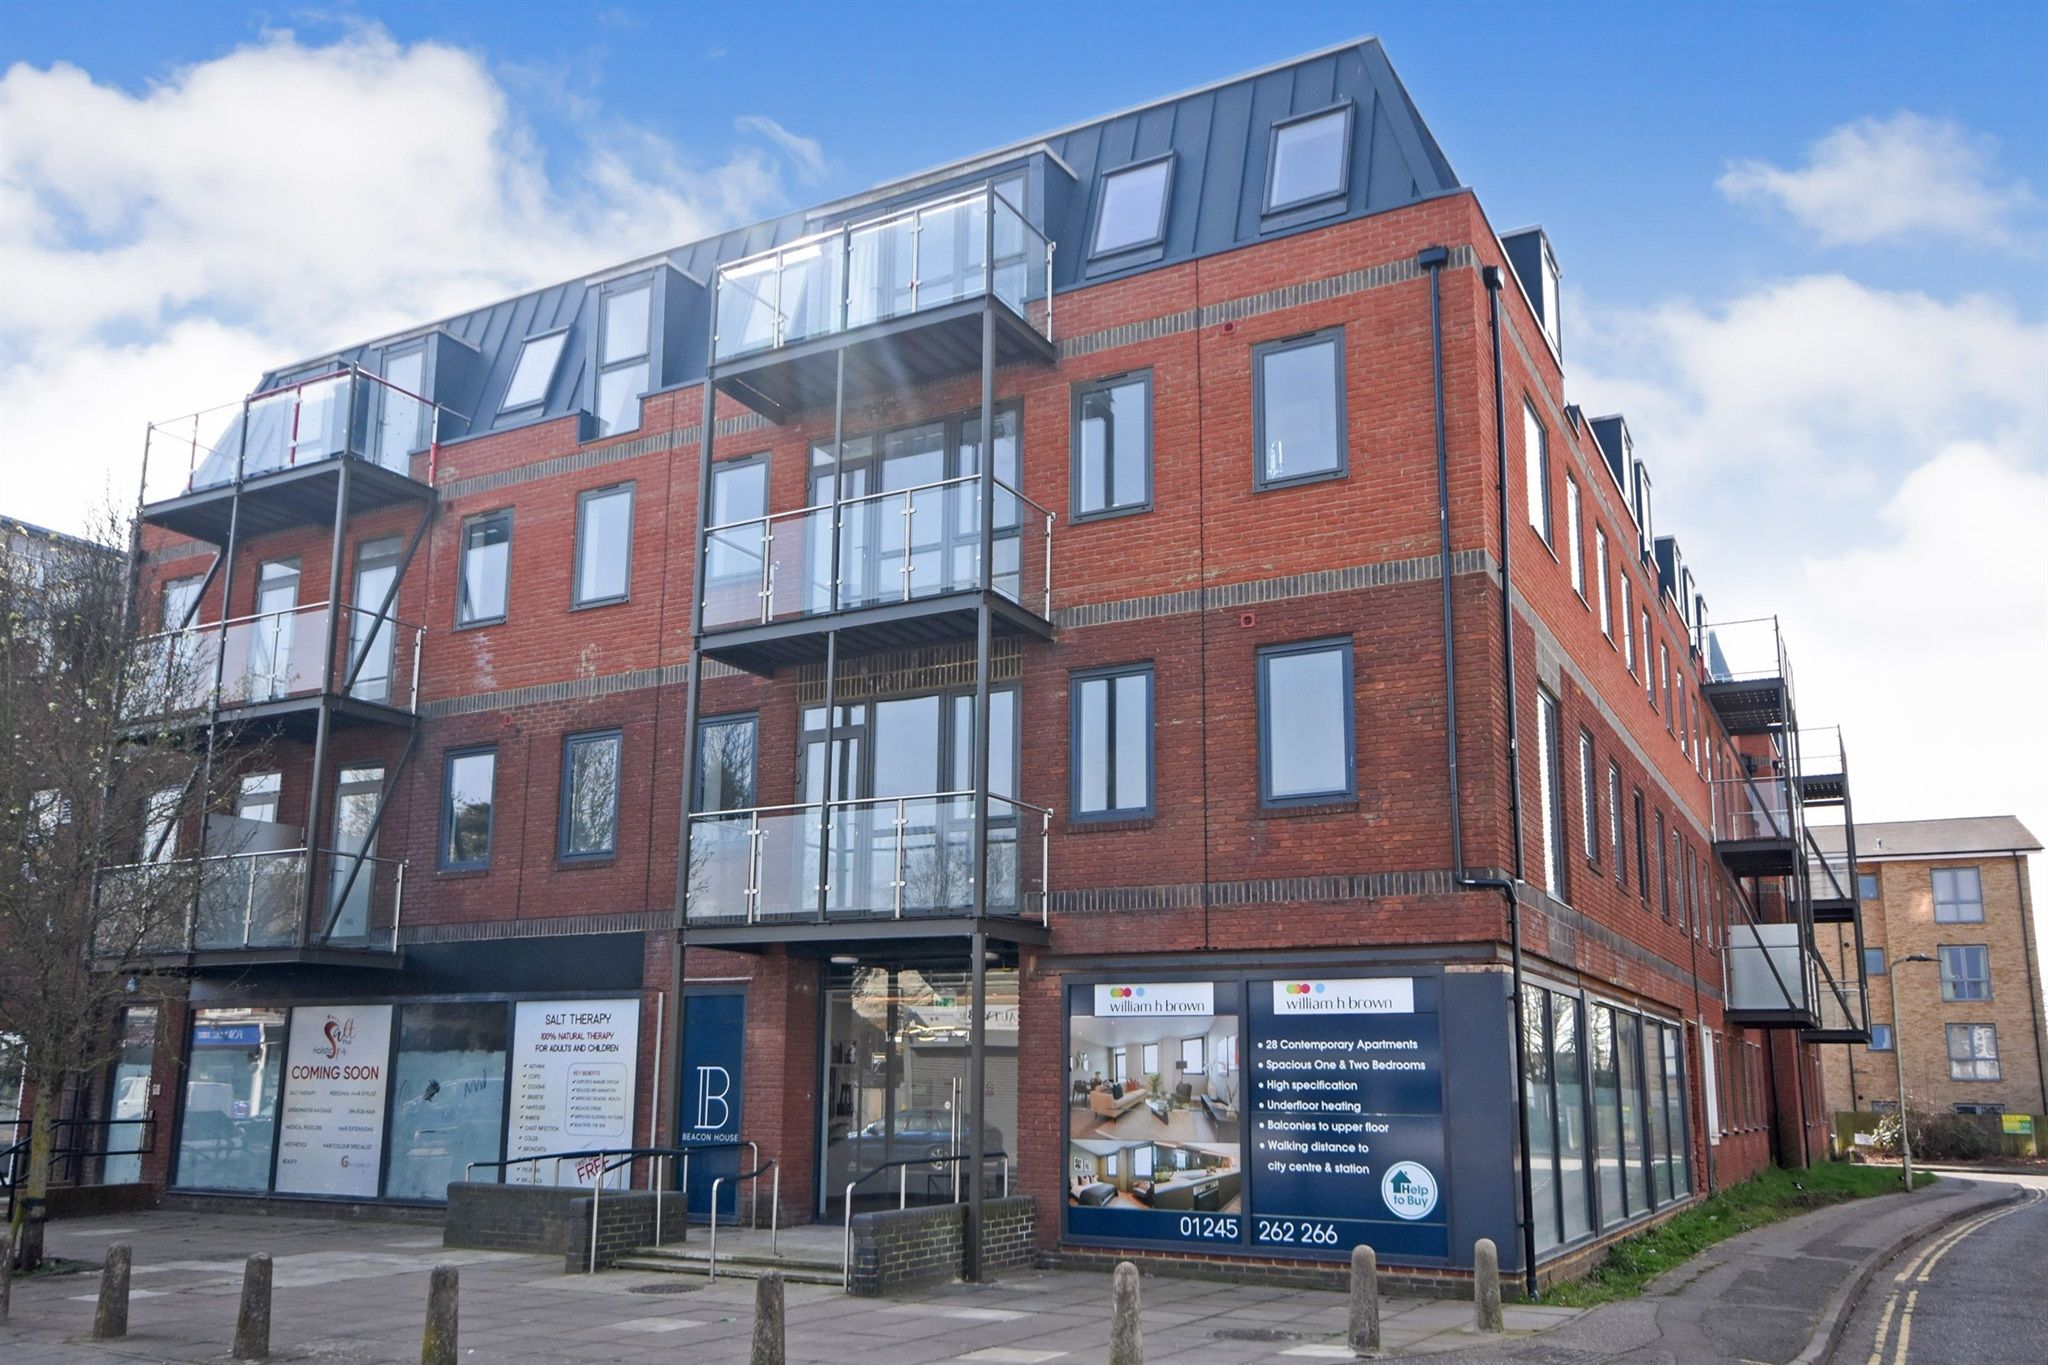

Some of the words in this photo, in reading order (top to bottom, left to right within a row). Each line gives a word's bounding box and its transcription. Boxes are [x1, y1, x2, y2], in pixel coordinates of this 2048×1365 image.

[1110, 1000, 1152, 1012] william
[1155, 999, 1163, 1012] h
[1165, 999, 1205, 1012] brown
[1286, 996, 1333, 1010] william
[1336, 996, 1345, 1009] h
[1348, 996, 1393, 1010] brown
[545, 1014, 567, 1026] SALT
[570, 1013, 612, 1025] THERAPY
[558, 1032, 585, 1040] NATURAL
[587, 1032, 615, 1040] THERAPY
[535, 1045, 549, 1053] FOR
[549, 1045, 572, 1053] ADULTS
[573, 1045, 587, 1053] AND
[588, 1044, 620, 1052] CHILDREN
[1266, 1039, 1278, 1050] 28
[1280, 1039, 1354, 1052] Contemporary
[1357, 1039, 1418, 1052] Apartments
[1266, 1060, 1312, 1072] Spacious
[1314, 1060, 1337, 1070] One
[1339, 1060, 1347, 1070] &
[1349, 1060, 1370, 1070] Two
[1372, 1060, 1426, 1071] Bedrooms
[292, 1066, 341, 1080] COMING
[343, 1066, 380, 1080] SOON
[1266, 1080, 1290, 1092] High
[1291, 1080, 1358, 1092] specification
[694, 1066, 731, 1129] B
[1267, 1100, 1320, 1112] Underfloor
[1321, 1101, 1361, 1114] heating
[1267, 1120, 1317, 1131] Balconies
[1318, 1121, 1330, 1131] to
[1331, 1123, 1363, 1134] upper
[1365, 1121, 1390, 1133] floor
[682, 1132, 712, 1142] BEACON
[714, 1133, 739, 1143] HOUSE
[1267, 1140, 1309, 1154] Walking
[1311, 1142, 1356, 1153] distance
[1358, 1143, 1370, 1153] to
[1267, 1161, 1287, 1173] city
[1288, 1162, 1323, 1173] centre
[1324, 1163, 1333, 1173] &
[1335, 1163, 1370, 1175] station
[1402, 1183, 1429, 1197] Help
[1393, 1196, 1405, 1206] to
[1407, 1197, 1429, 1208] Buy
[1180, 1216, 1239, 1239] 01245
[1259, 1220, 1295, 1242] 262
[1300, 1222, 1339, 1244] 266
